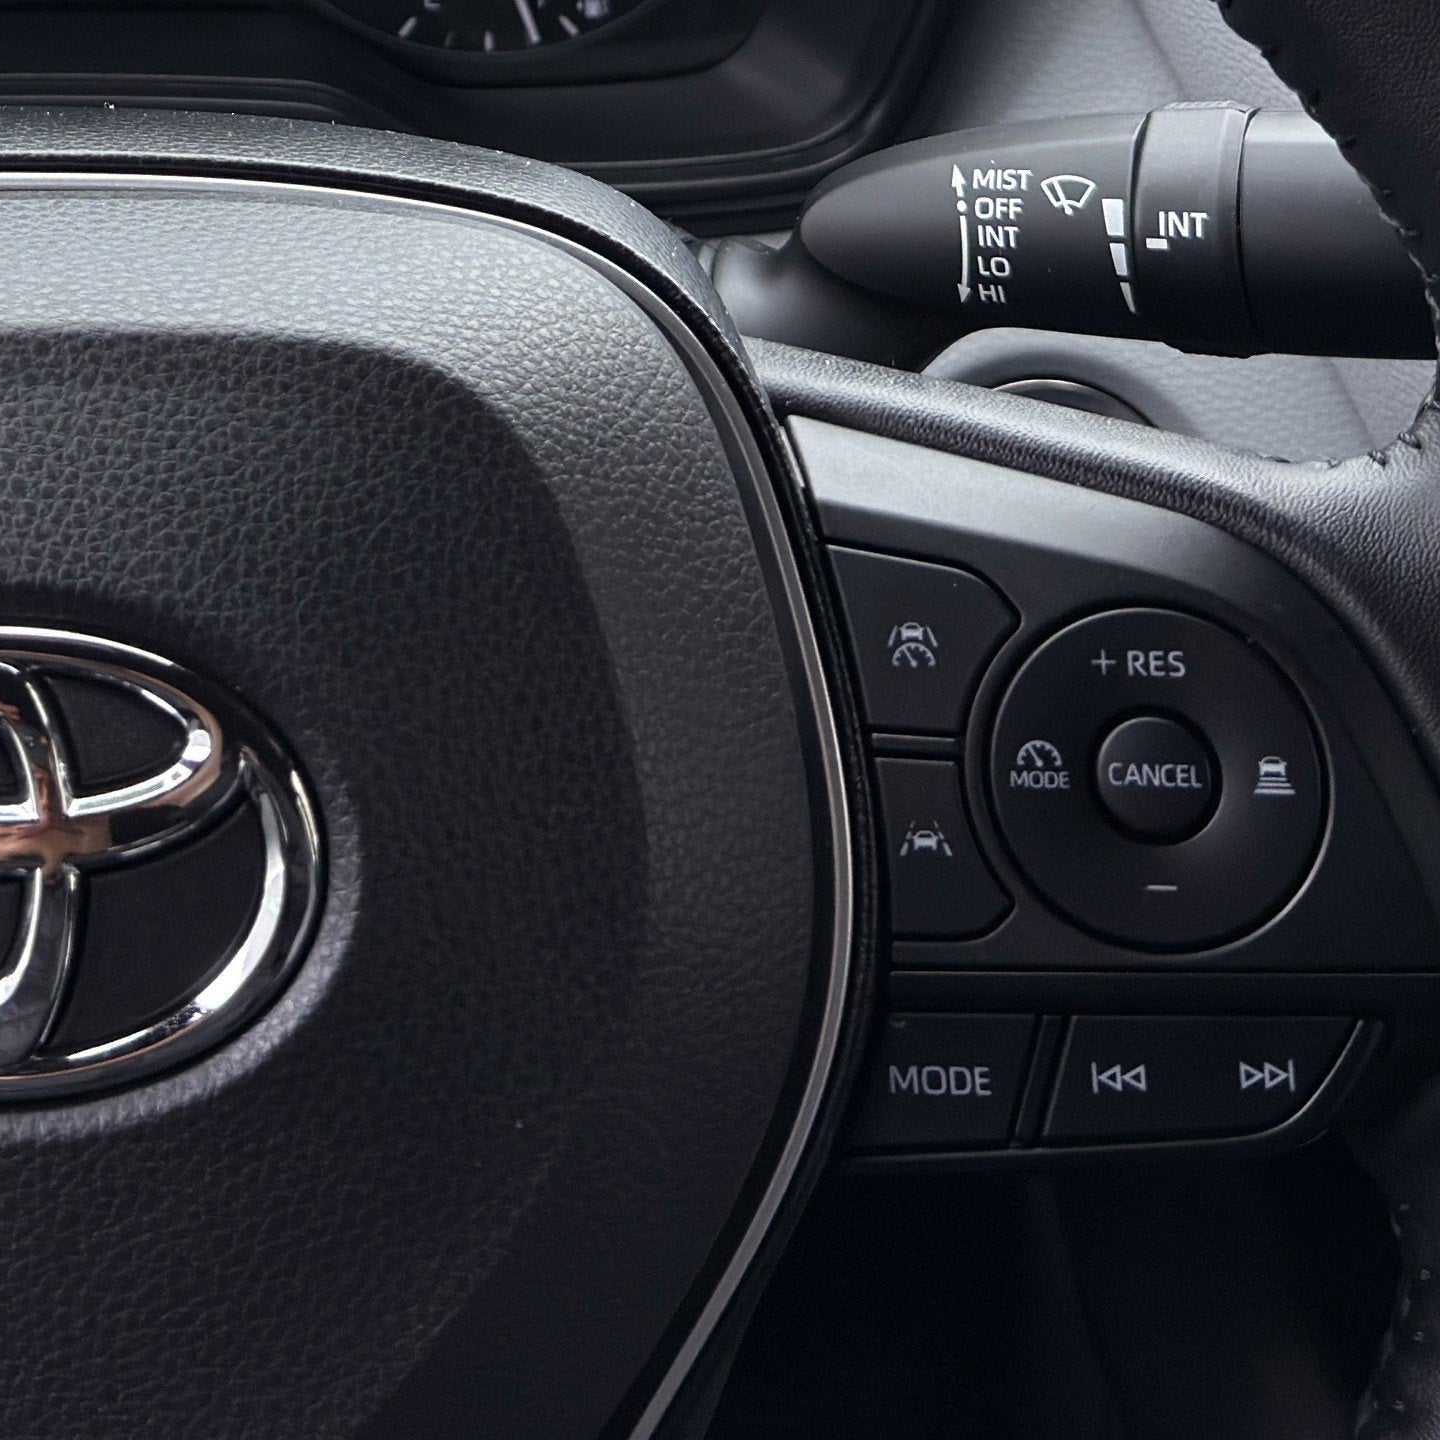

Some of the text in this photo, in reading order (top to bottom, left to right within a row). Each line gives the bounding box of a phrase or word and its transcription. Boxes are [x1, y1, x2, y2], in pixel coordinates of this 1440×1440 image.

[972, 169, 1031, 190] MIST
[974, 197, 1022, 219] OFF
[1158, 211, 1207, 239] INT
[977, 225, 1018, 248] INT
[978, 255, 1010, 277] LO
[979, 283, 1006, 304] HI
[1127, 650, 1185, 678] RES
[1011, 770, 1069, 790] MODE
[1108, 762, 1202, 788] CANCEL
[889, 1066, 992, 1095] MODE
